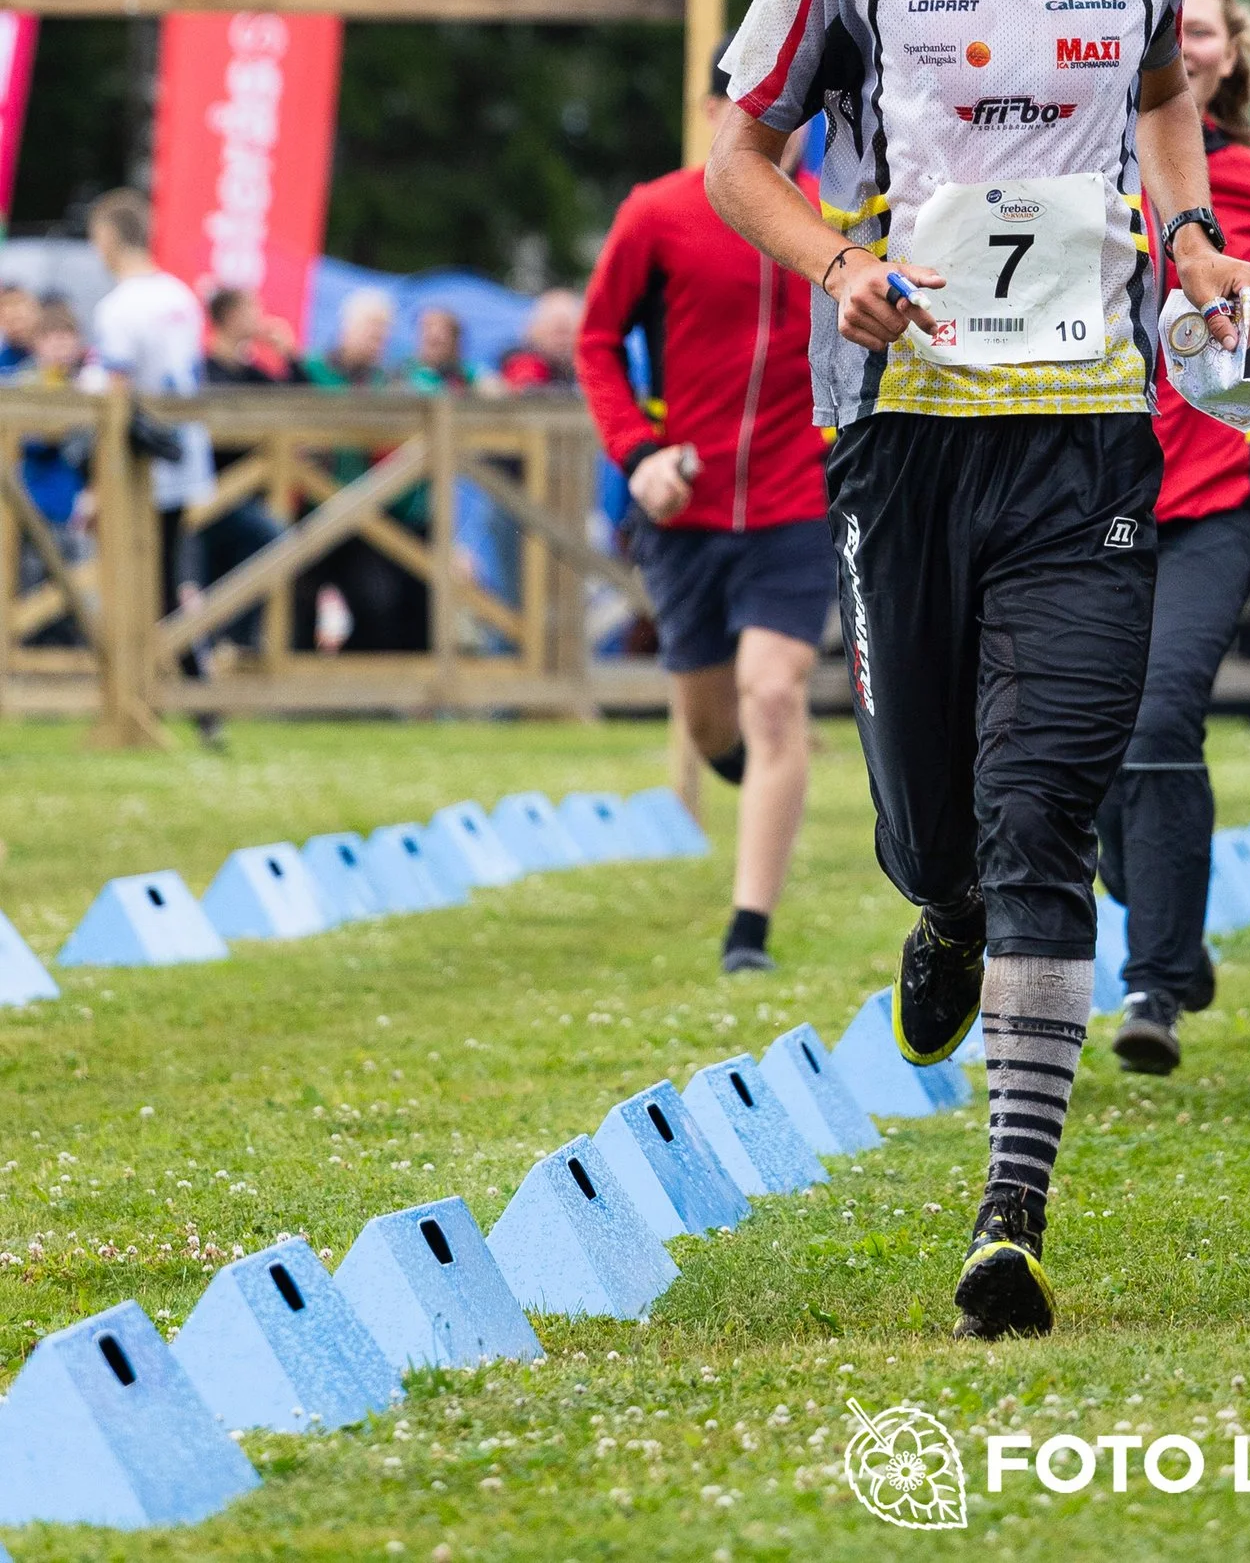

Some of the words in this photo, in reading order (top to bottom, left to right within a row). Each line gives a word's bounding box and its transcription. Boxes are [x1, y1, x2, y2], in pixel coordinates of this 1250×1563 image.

[908, 0, 979, 12] LOIPART
[1045, 0, 1126, 11] Calambio
[903, 42, 957, 55] Sparbanken
[1056, 38, 1120, 61] MAXI
[917, 55, 957, 67] Alingsås
[1070, 61, 1120, 69] STORMARKNAD
[972, 97, 1060, 125] fri-bo
[1000, 204, 1040, 213] frebaco
[988, 234, 1035, 299] 7
[1055, 319, 1087, 342] 10
